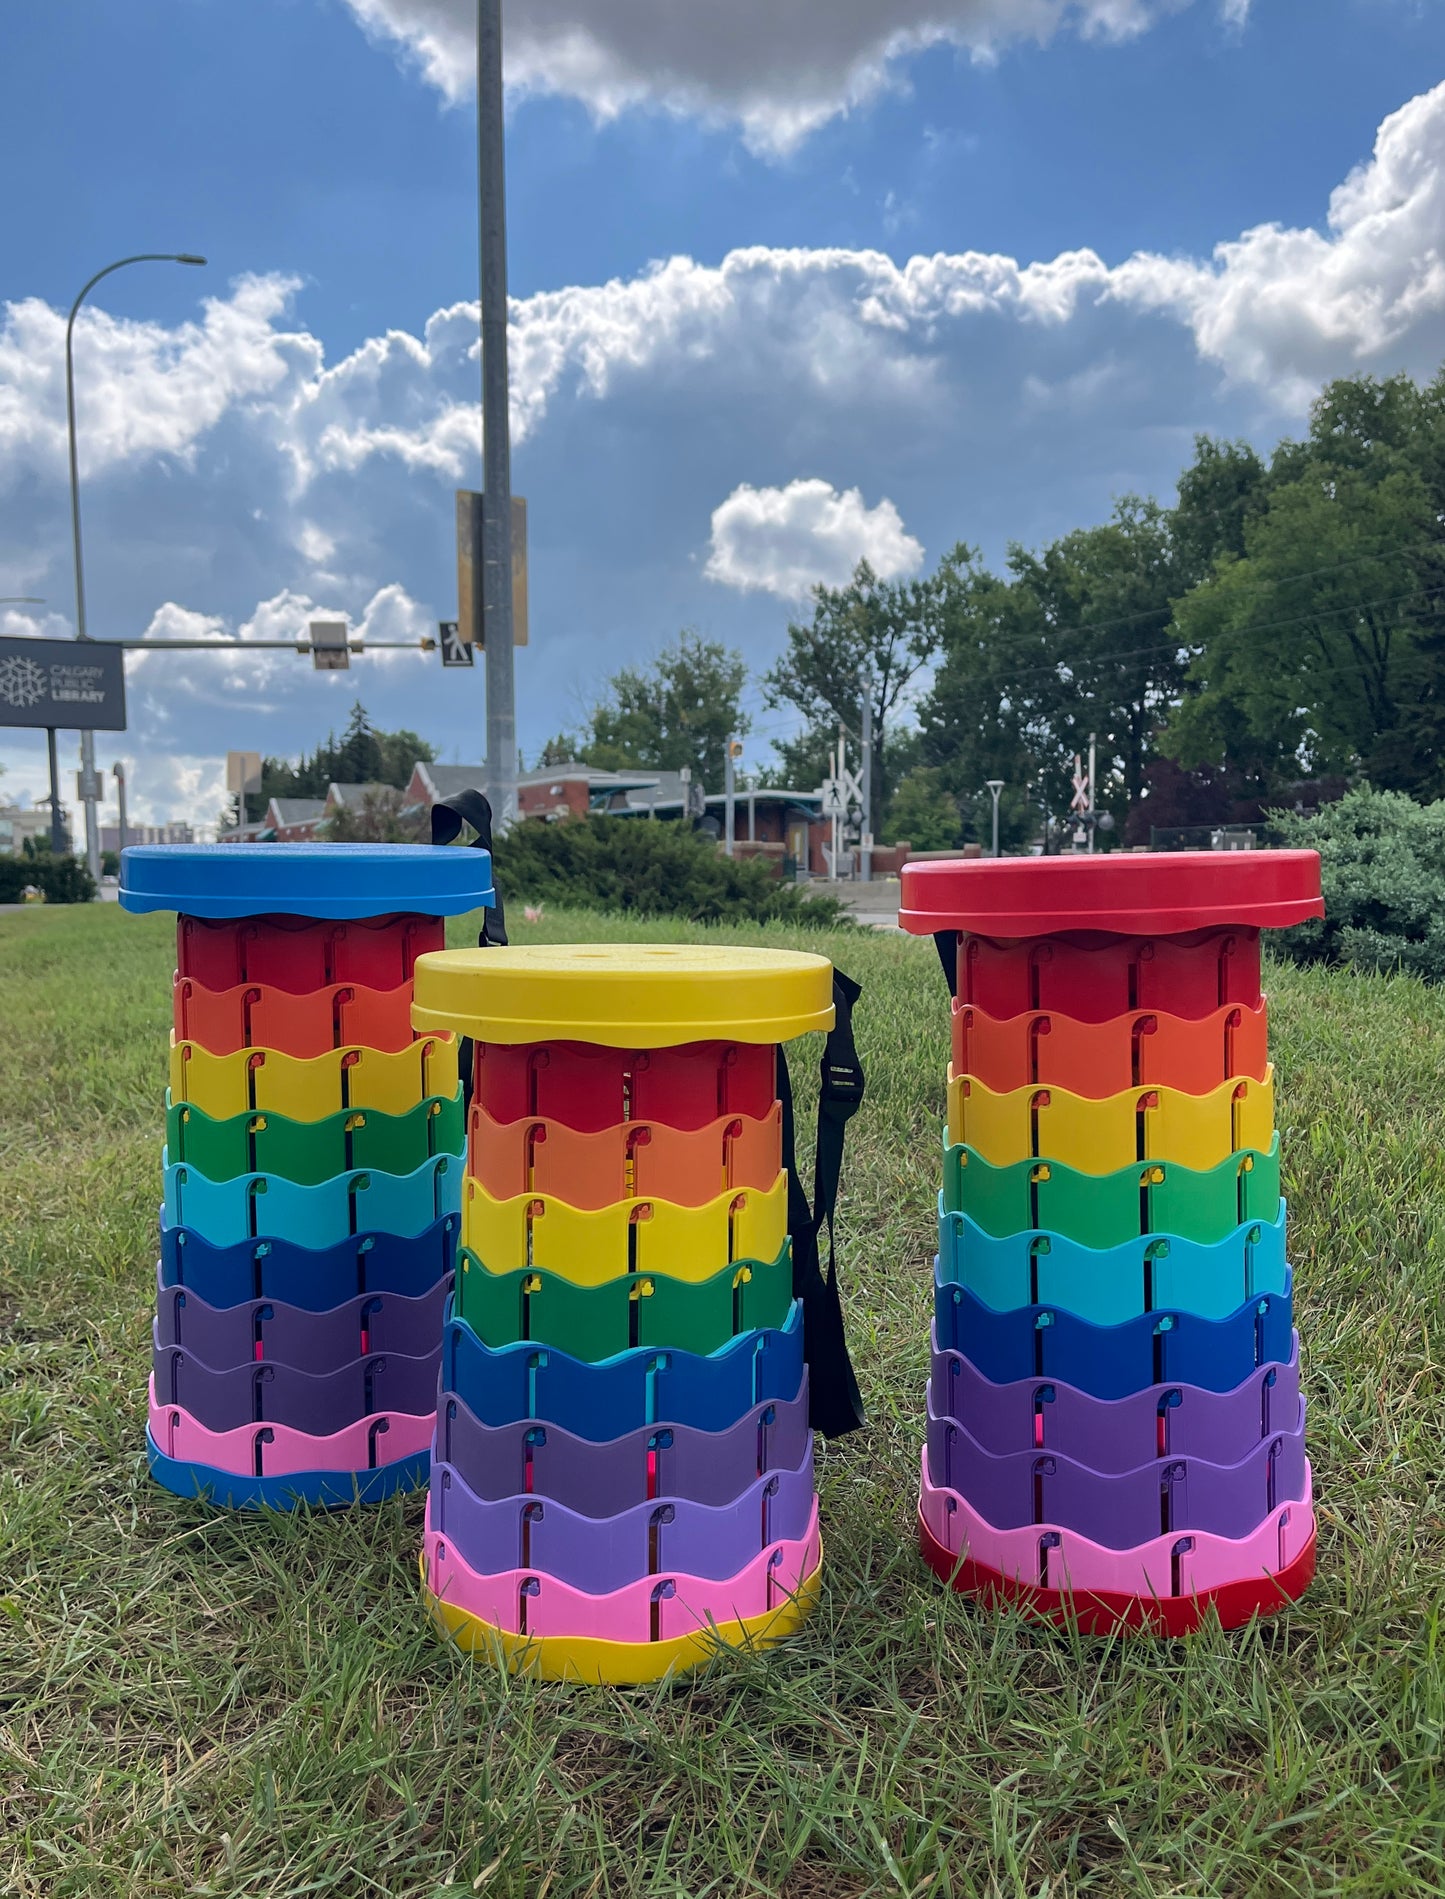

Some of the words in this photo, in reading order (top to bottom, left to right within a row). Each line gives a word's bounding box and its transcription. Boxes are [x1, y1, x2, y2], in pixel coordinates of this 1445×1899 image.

[50, 664, 104, 678] CALGARY
[51, 678, 95, 690] PUBLIC
[52, 690, 105, 703] LIBRARY
